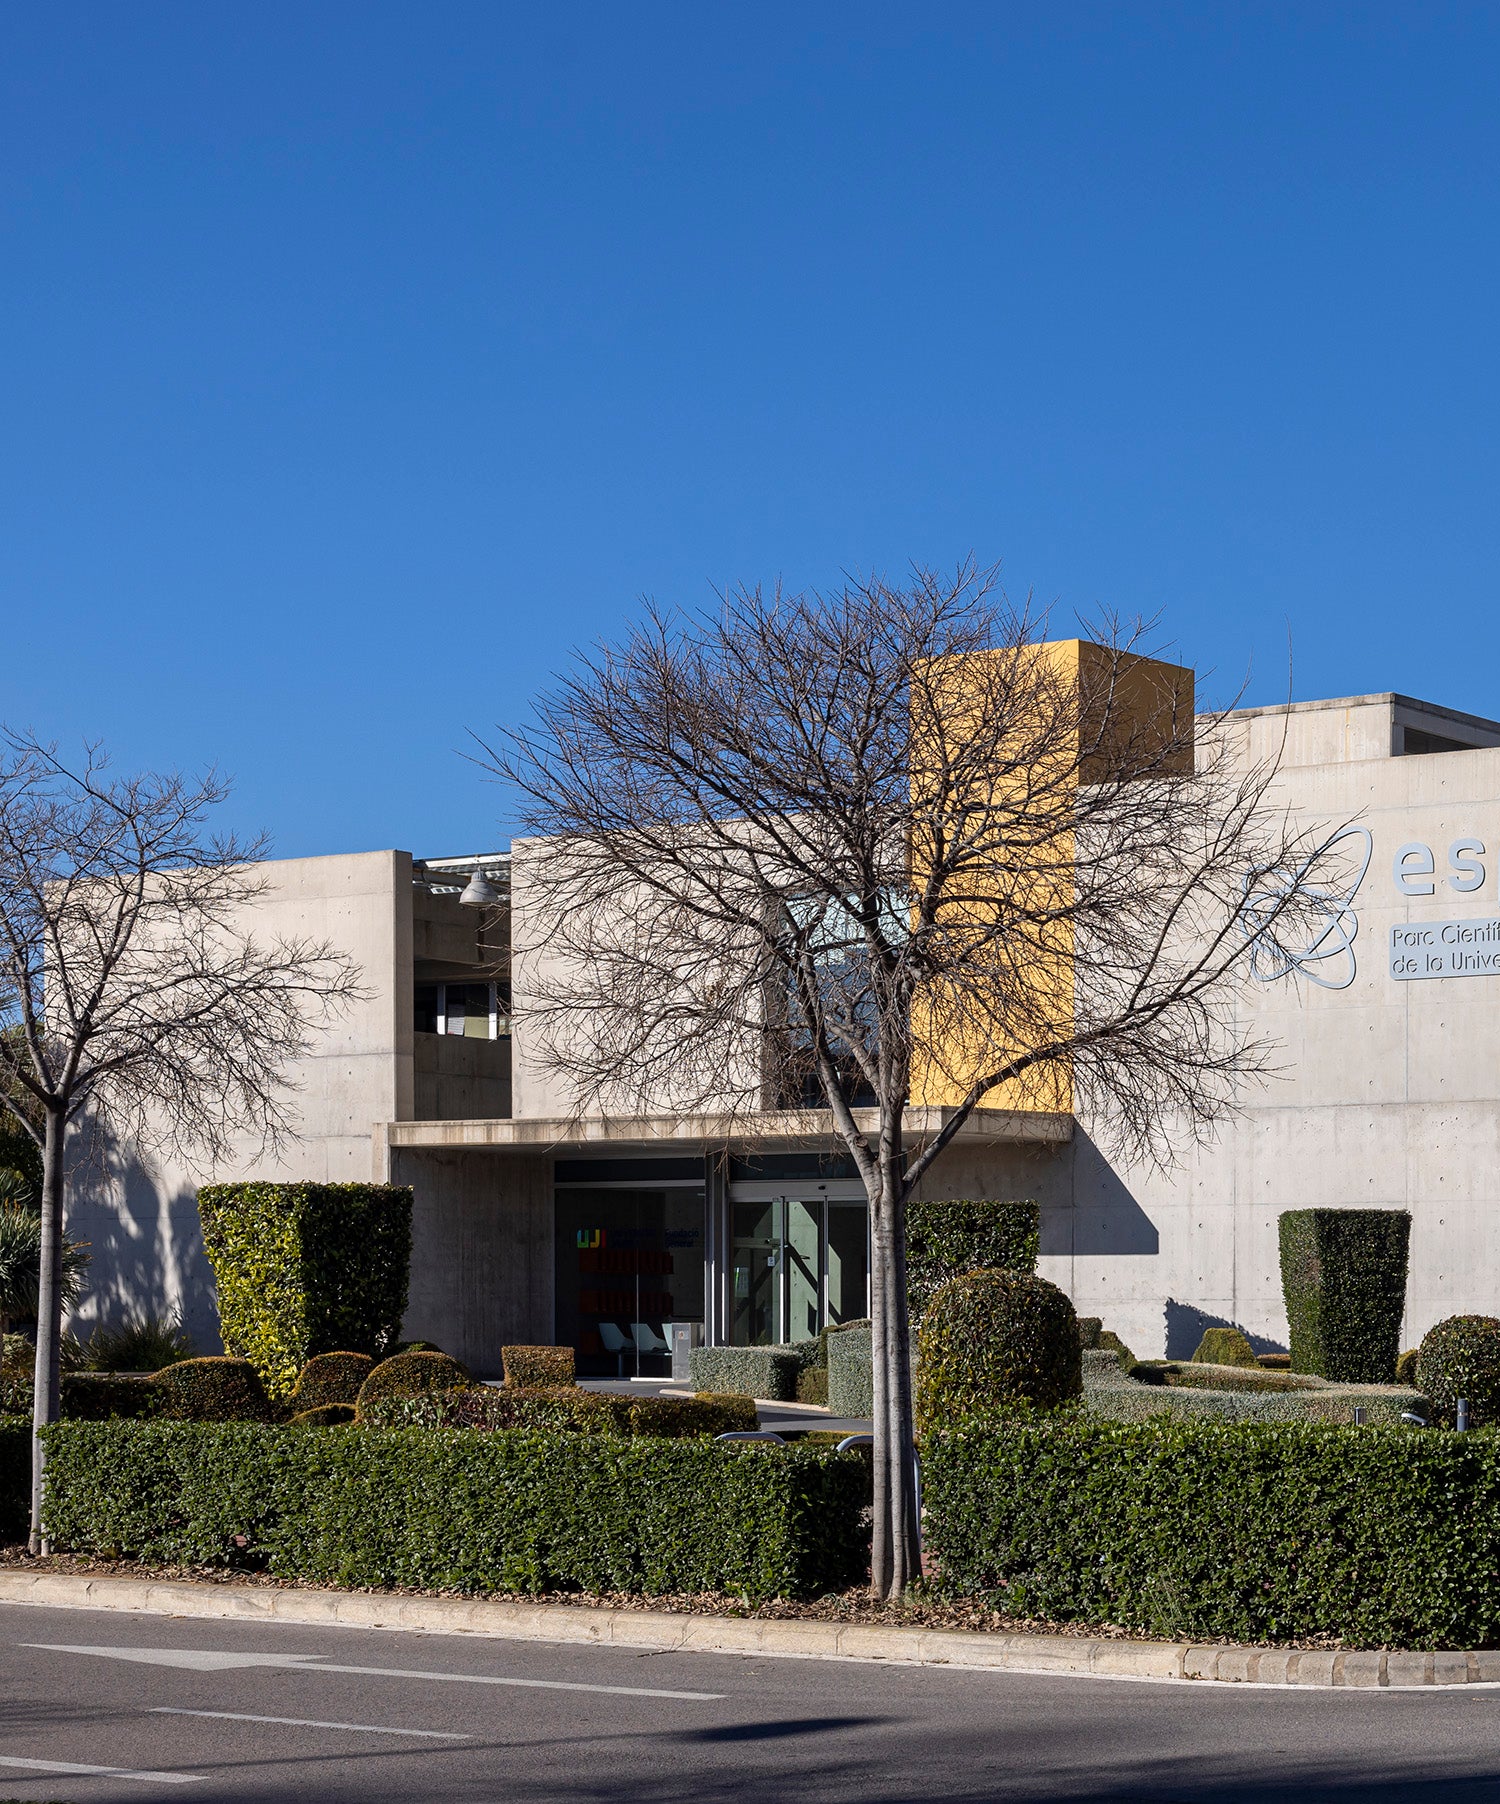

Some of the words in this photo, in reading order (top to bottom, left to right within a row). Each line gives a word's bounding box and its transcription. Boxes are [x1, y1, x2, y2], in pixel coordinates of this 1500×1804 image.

[1393, 929, 1435, 948] Parc
[1392, 955, 1418, 974] de
[1426, 953, 1443, 972] la
[577, 1229, 607, 1249] UJI
